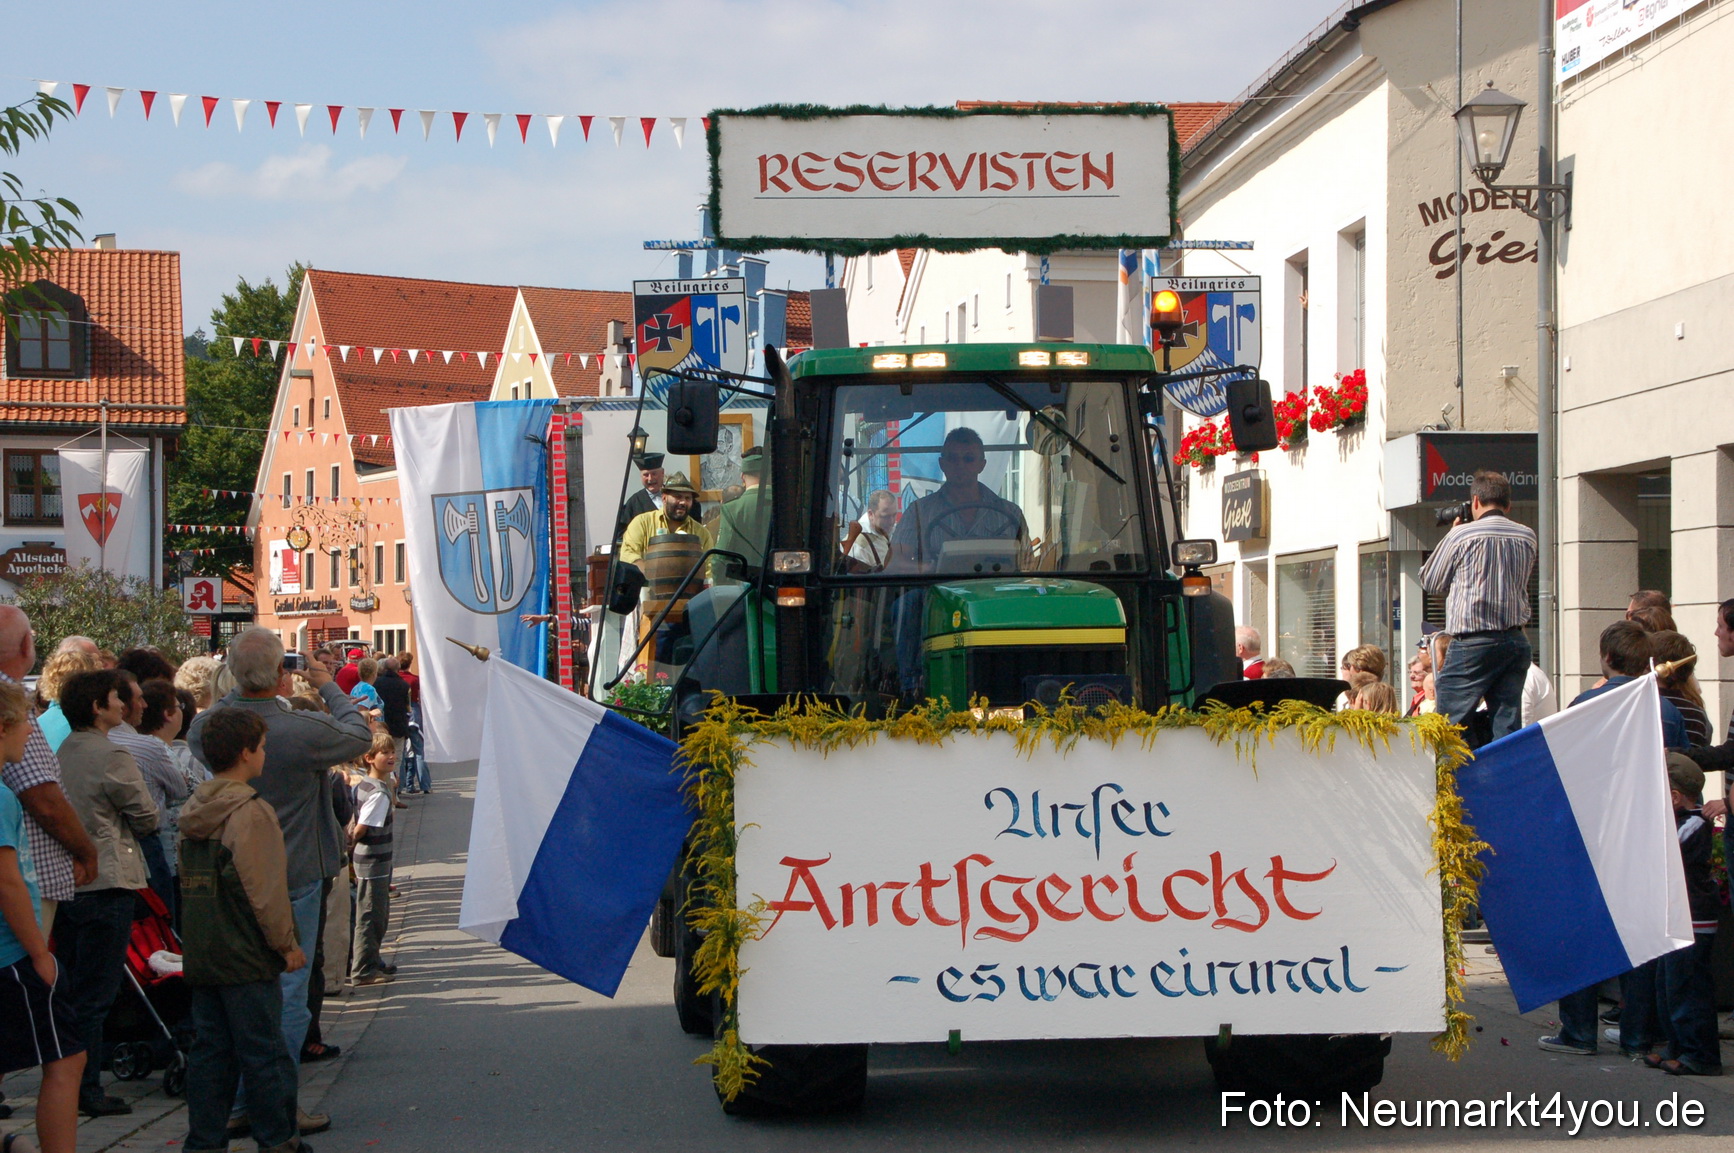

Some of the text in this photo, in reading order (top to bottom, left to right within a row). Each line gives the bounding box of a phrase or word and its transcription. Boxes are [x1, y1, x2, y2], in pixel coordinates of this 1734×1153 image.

[756, 151, 1115, 193] RESERVISTEN
[1418, 186, 1538, 227] MODEH
[651, 281, 729, 294] Beilngries
[1168, 278, 1245, 292] Beilngries
[1433, 472, 1475, 486] Mode
[936, 963, 1006, 1003] es
[1016, 962, 1139, 1002] war
[1150, 945, 1369, 998] einmal
